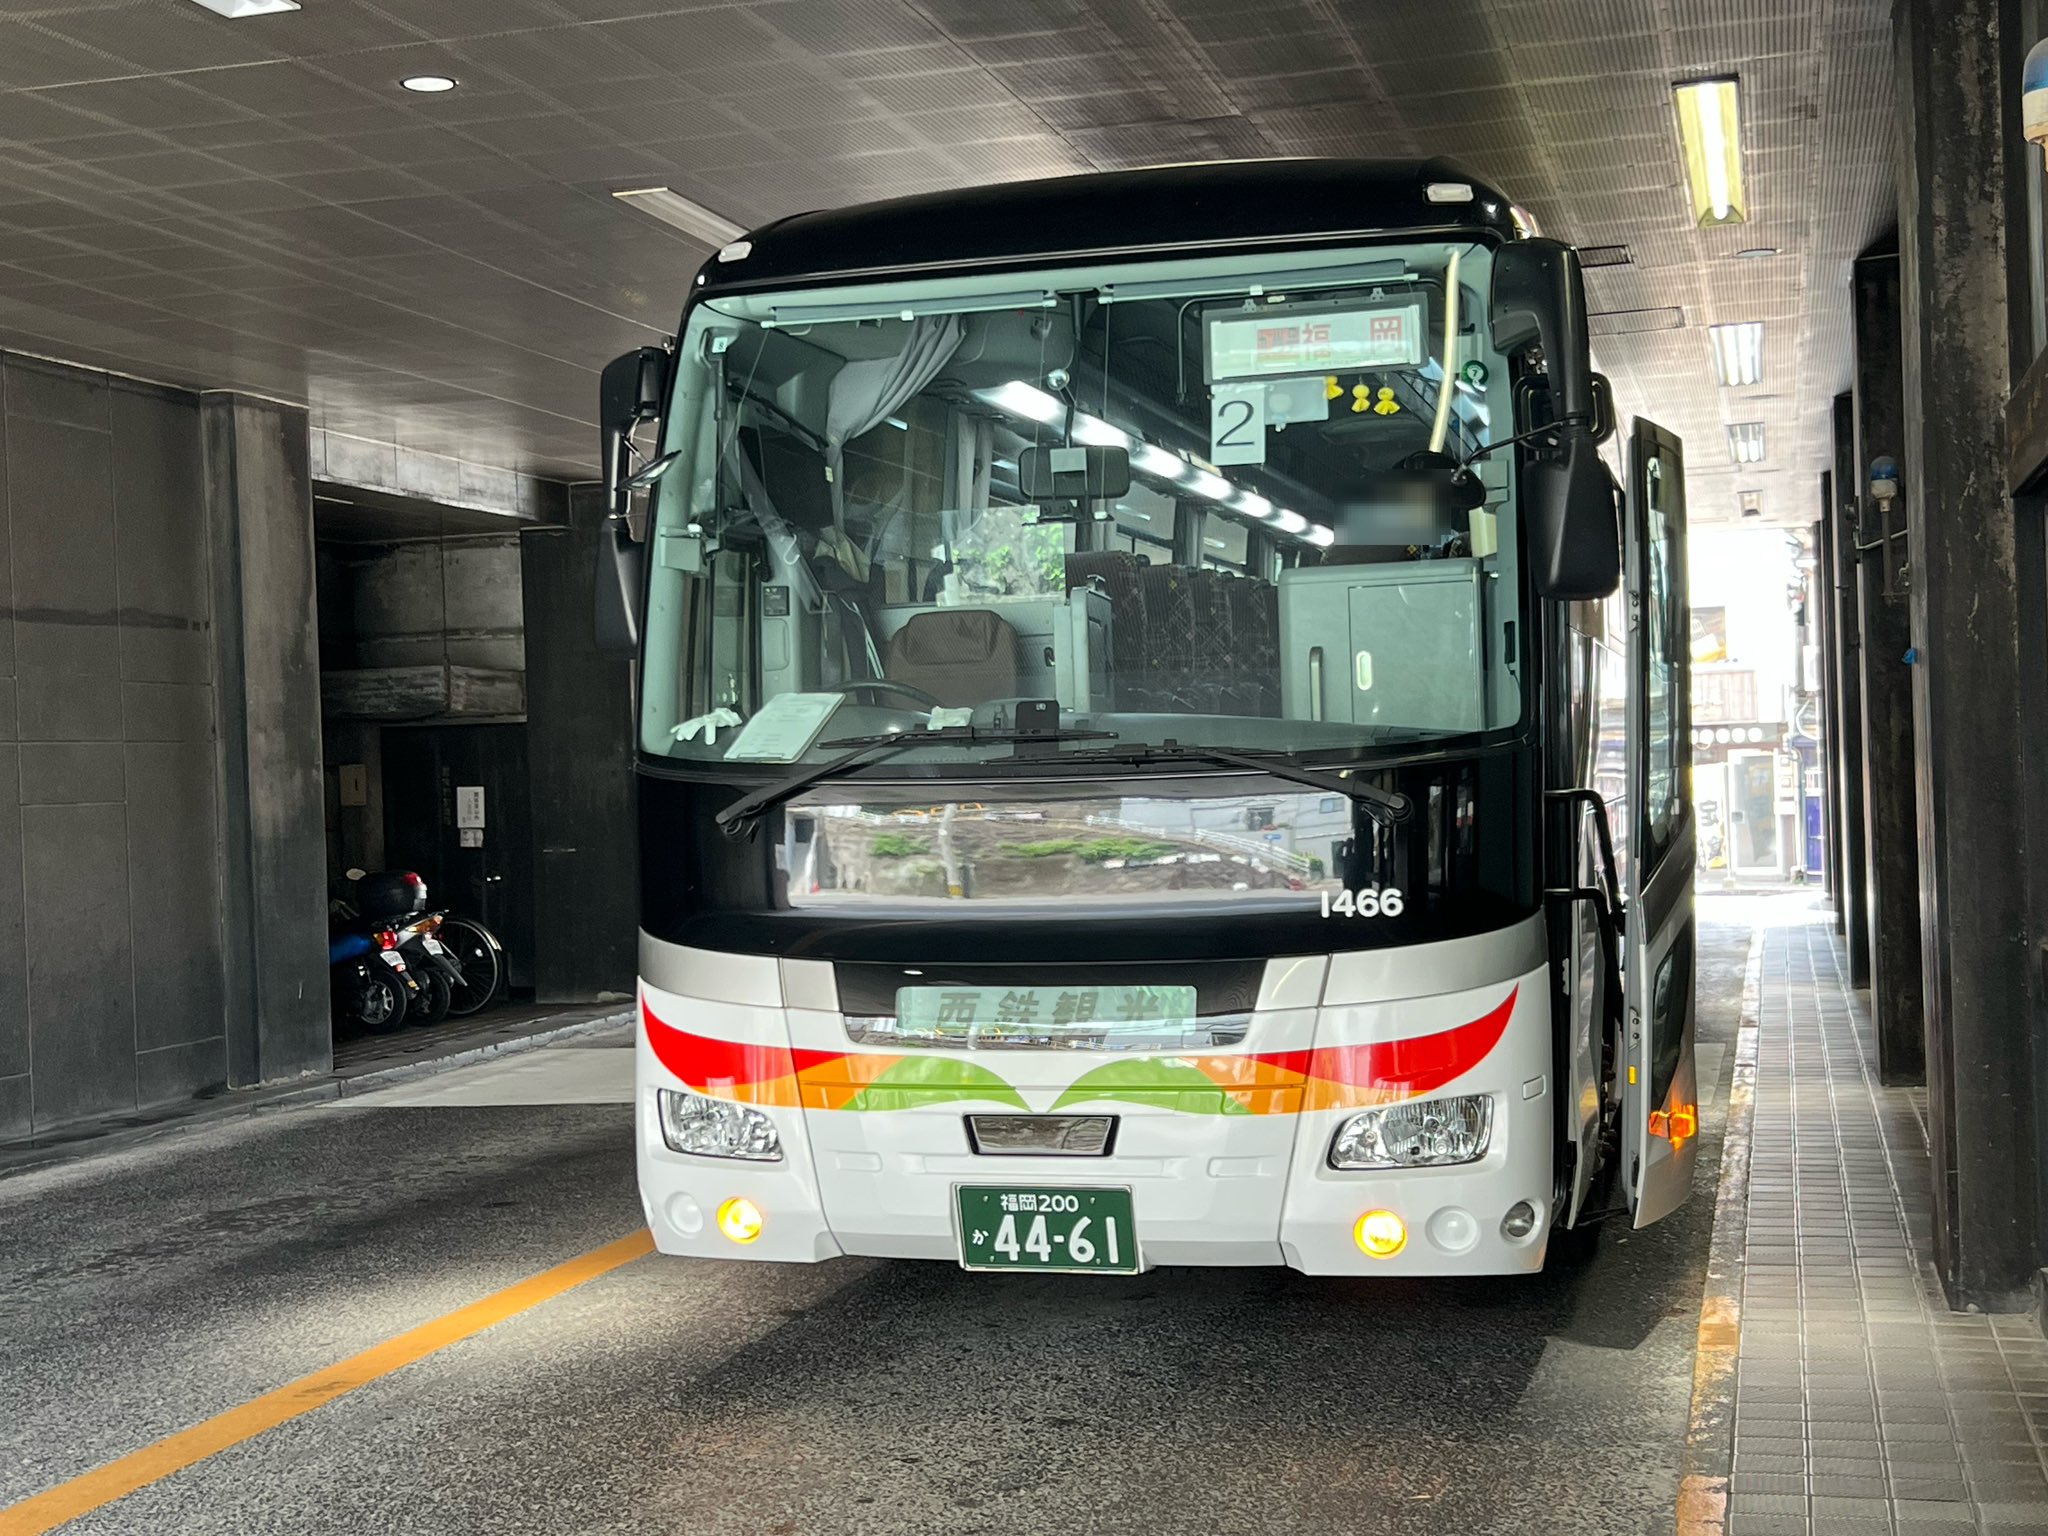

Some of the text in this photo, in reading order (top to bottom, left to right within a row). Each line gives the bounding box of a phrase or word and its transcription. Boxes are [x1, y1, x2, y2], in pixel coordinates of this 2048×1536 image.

[1216, 400, 1255, 447] 2
[1321, 888, 1404, 918] 1466
[937, 990, 1160, 1033] 西鉄観光
[972, 1214, 1119, 1264] か 44-61
